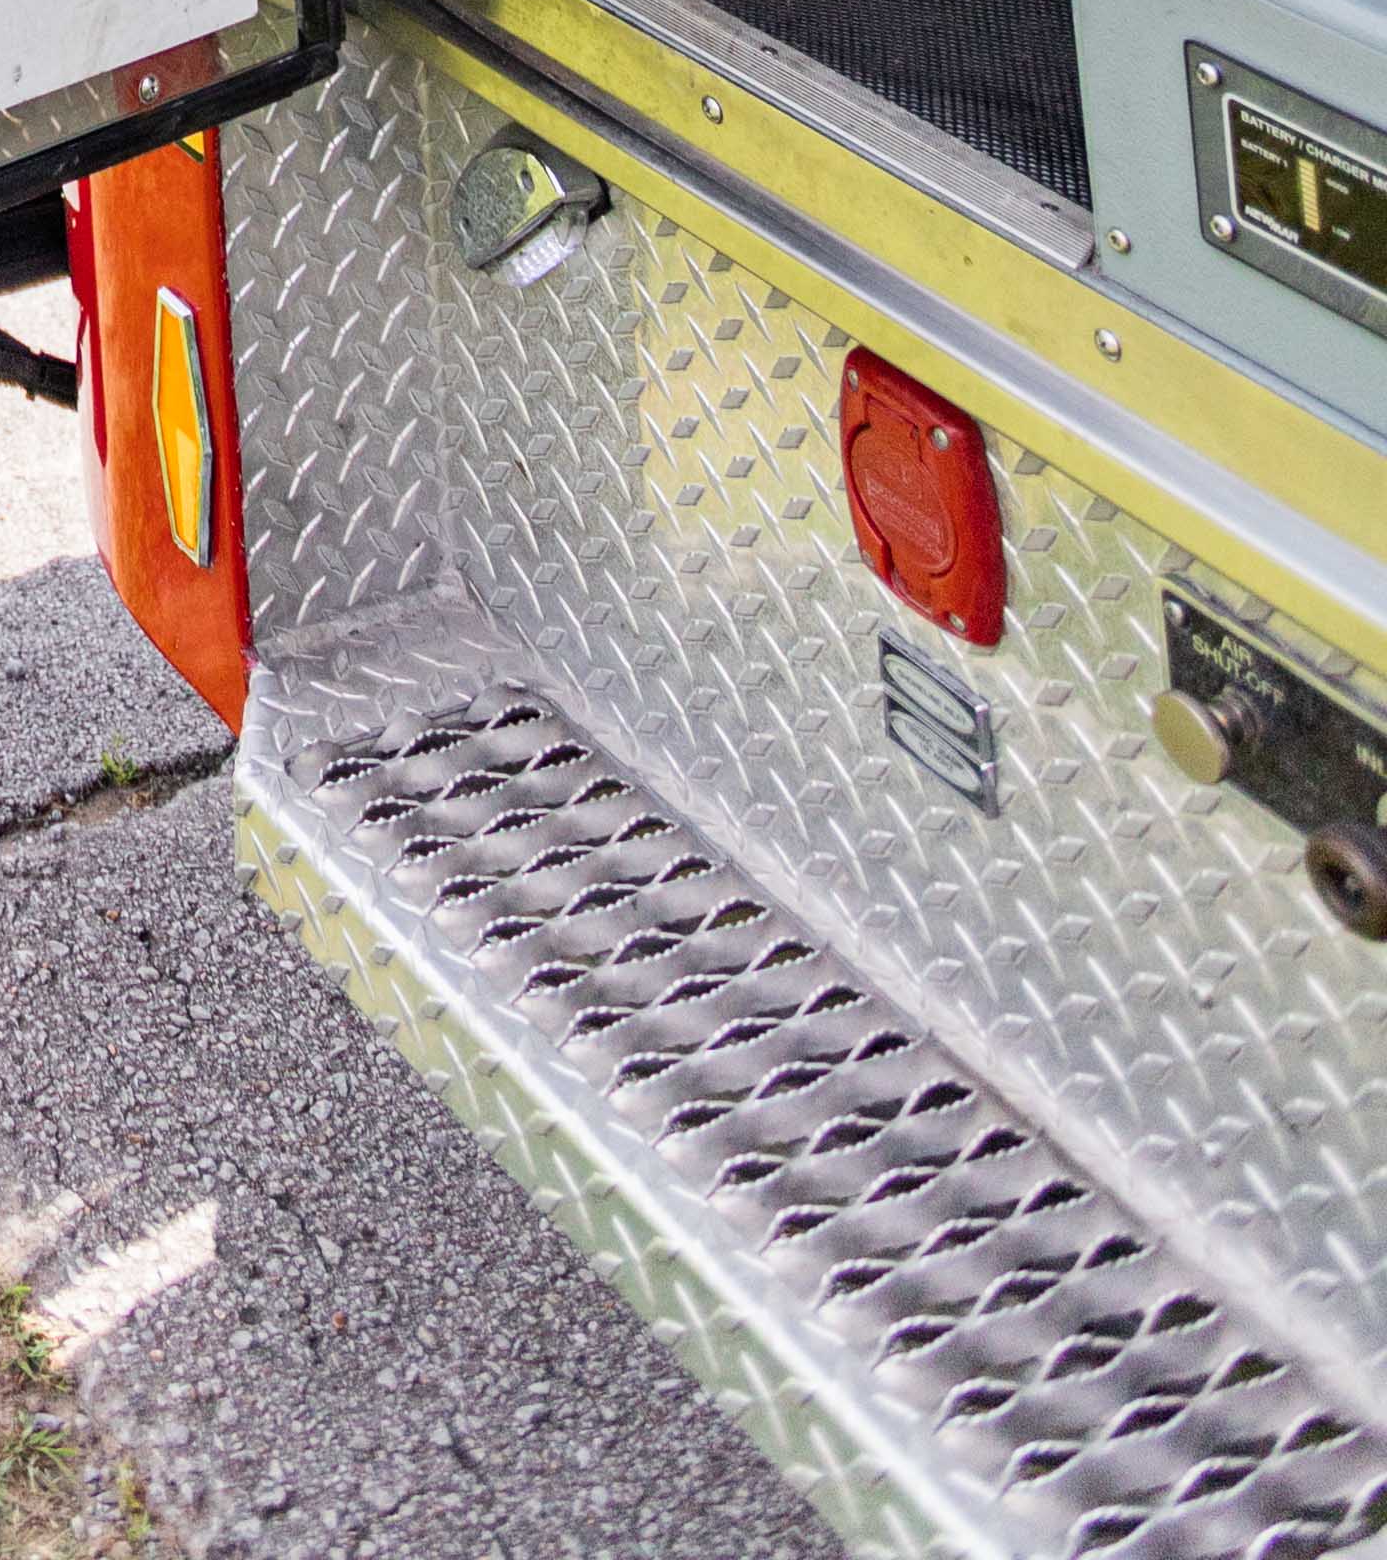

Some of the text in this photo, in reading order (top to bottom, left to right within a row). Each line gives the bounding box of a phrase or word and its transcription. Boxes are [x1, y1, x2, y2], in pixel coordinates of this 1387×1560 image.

[1240, 110, 1296, 148] BATTERY
[1305, 141, 1370, 184] CHARGER
[1240, 138, 1282, 166] BATTERY
[1221, 635, 1252, 666] AIR
